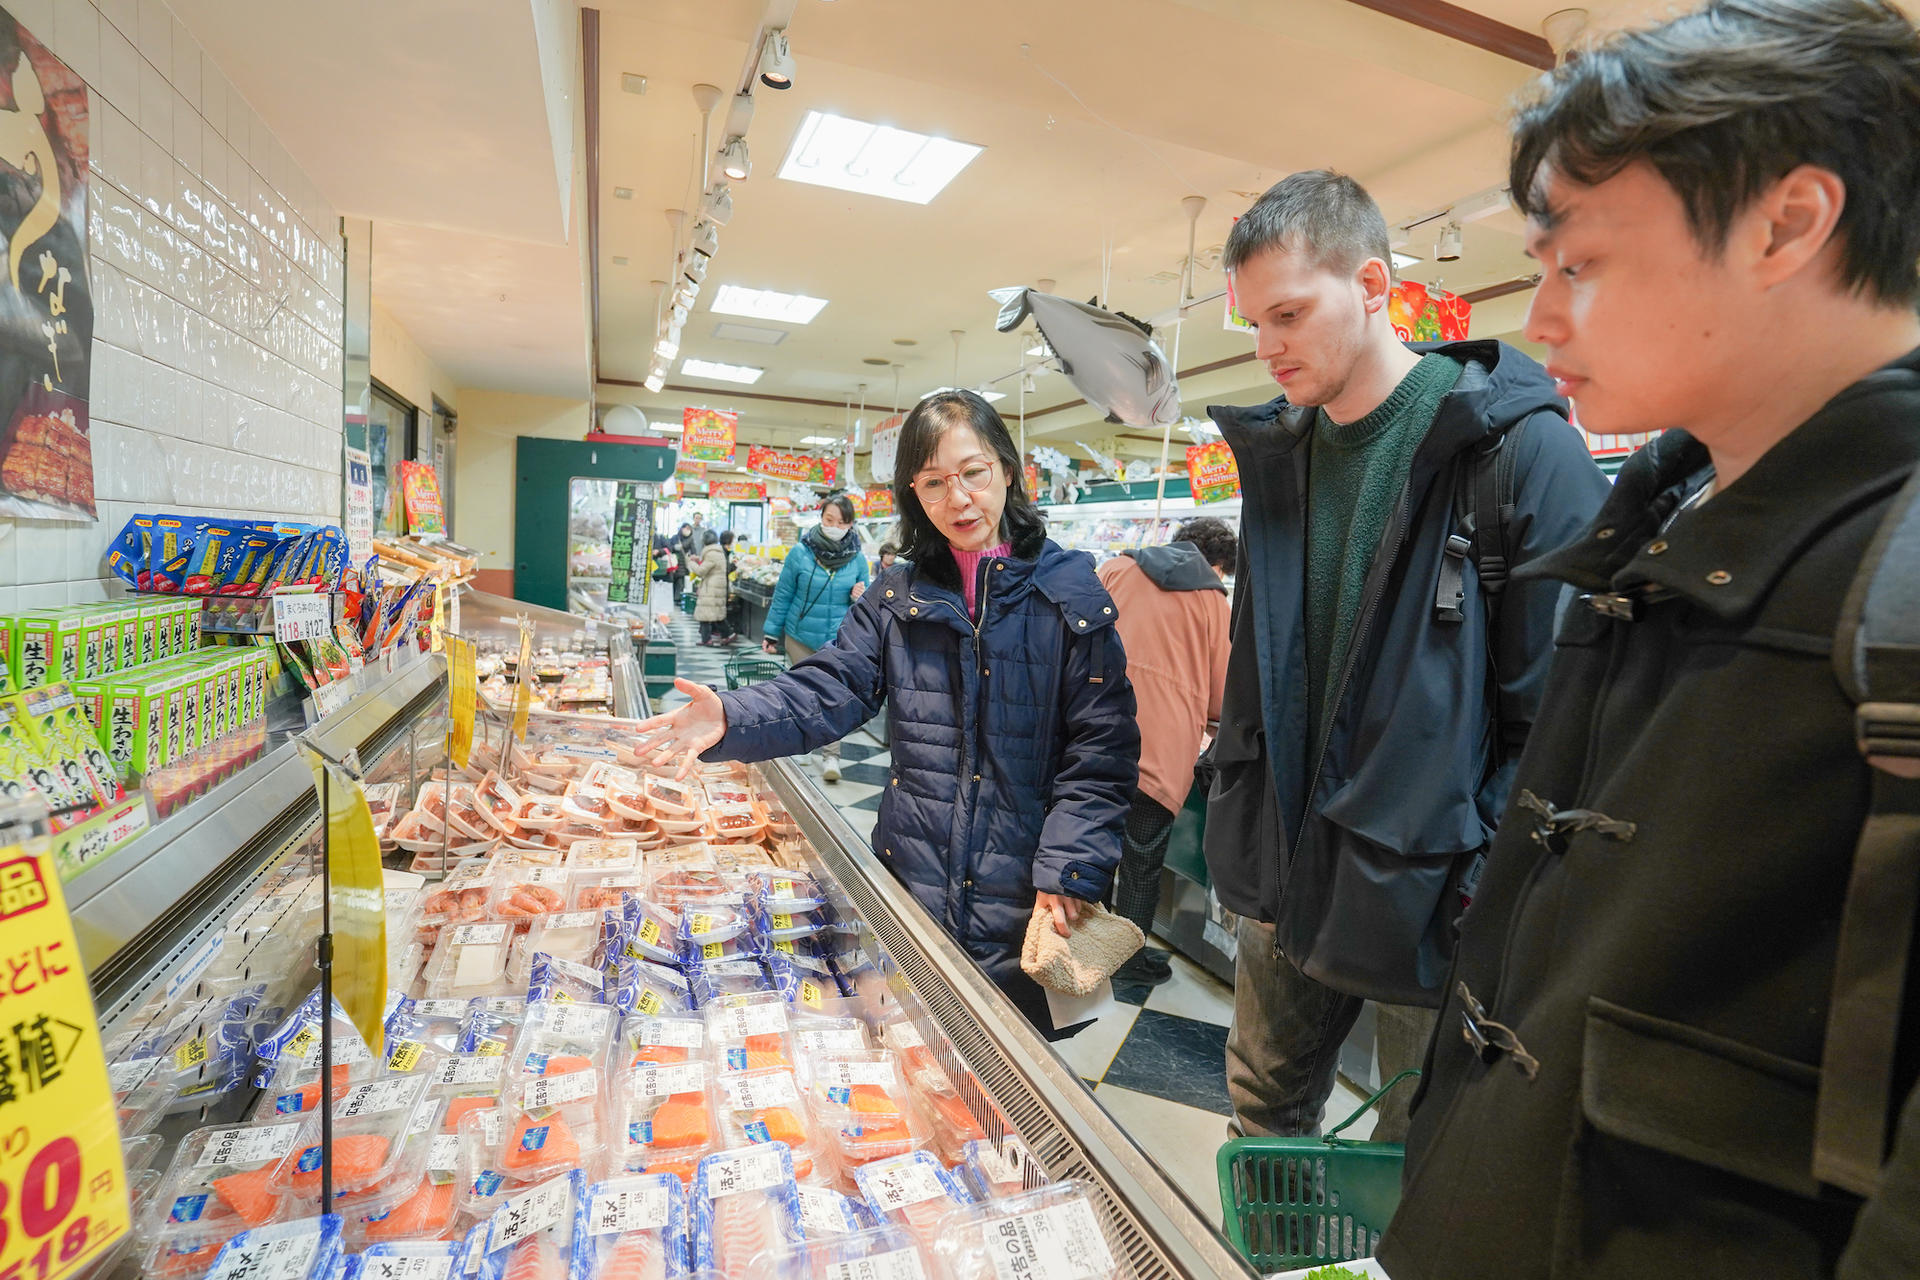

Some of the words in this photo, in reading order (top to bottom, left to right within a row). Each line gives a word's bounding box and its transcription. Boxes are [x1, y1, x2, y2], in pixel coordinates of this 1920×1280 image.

[686, 435, 734, 448] Christmas
[696, 428, 726, 438] Merry
[760, 462, 809, 477] Christmas
[772, 455, 803, 467] Merry
[1201, 462, 1232, 474] Merry
[1194, 473, 1239, 487] Christmas
[414, 486, 438, 501] Merry
[410, 499, 442, 512] Christmas
[220, 546, 235, 571] のたれ
[112, 706, 134, 763] 生わさび
[735, 1007, 749, 1036] 広告の品
[442, 1058, 460, 1083] 広告の品
[646, 1069, 657, 1096] 広告の品
[345, 1084, 374, 1117] 広告の品
[536, 1080, 548, 1107] 広告の品
[737, 1080, 755, 1108] 広告の品
[212, 1130, 240, 1165] 広告の品
[1033, 1215, 1049, 1233] 398
